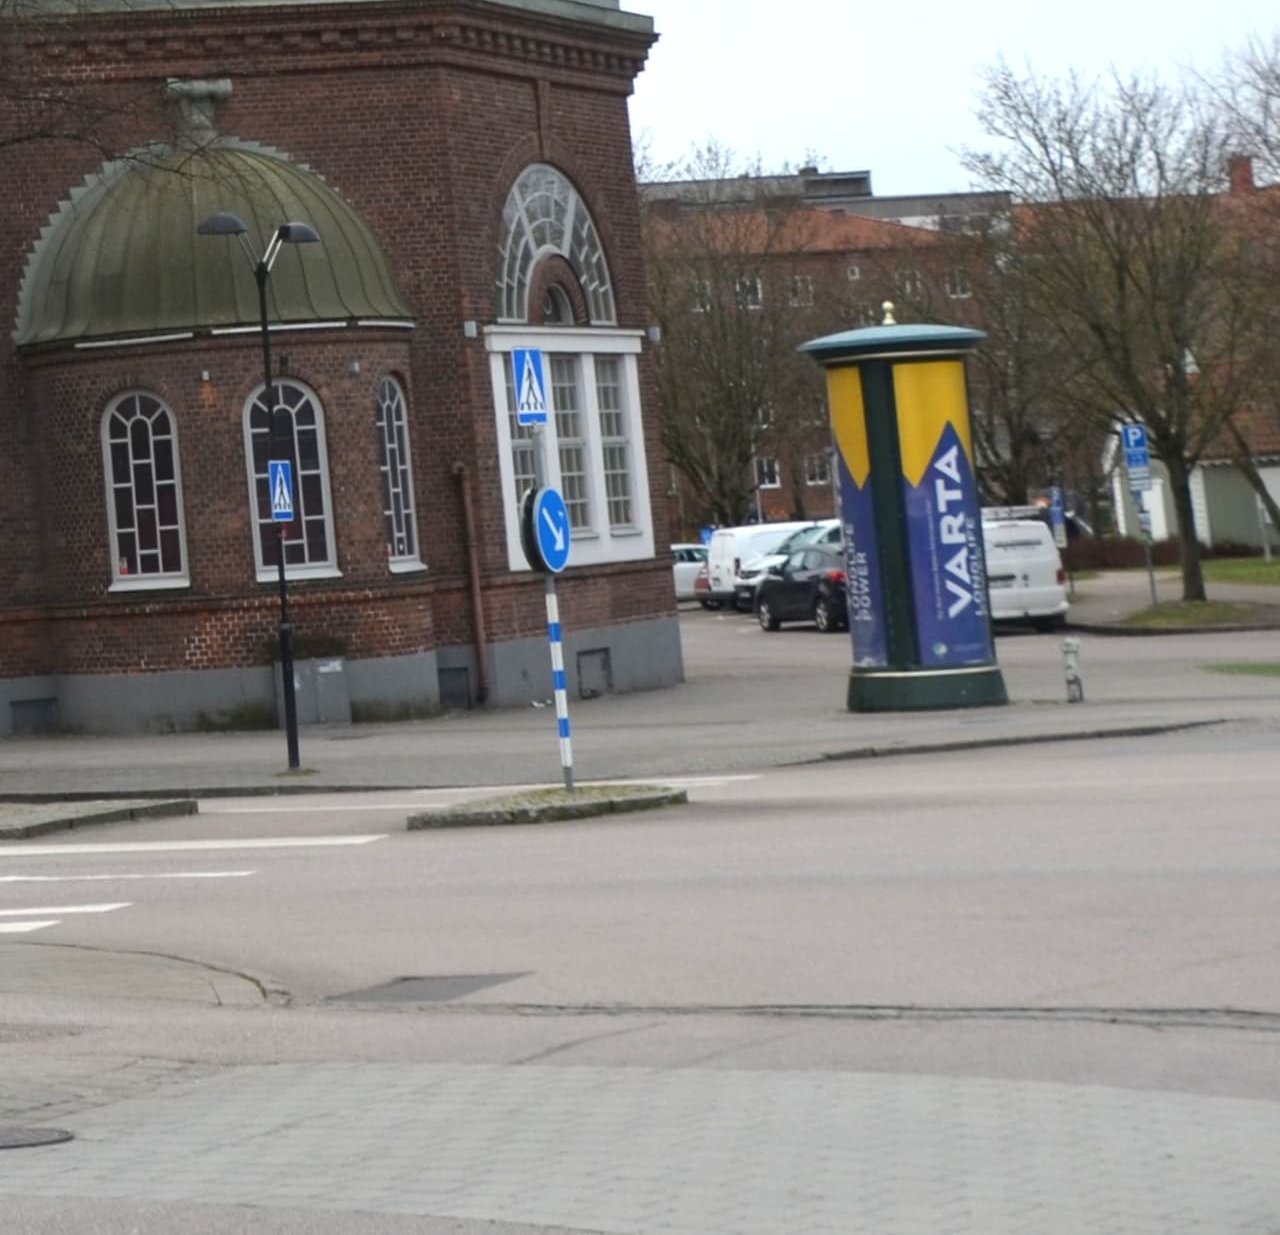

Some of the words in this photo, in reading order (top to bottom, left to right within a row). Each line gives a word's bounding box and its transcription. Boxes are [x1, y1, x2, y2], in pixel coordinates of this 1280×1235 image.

[1127, 427, 1142, 447] P
[933, 444, 973, 619] VARTA
[966, 517, 984, 617] LONGLIFE
[856, 551, 872, 621] POWER
